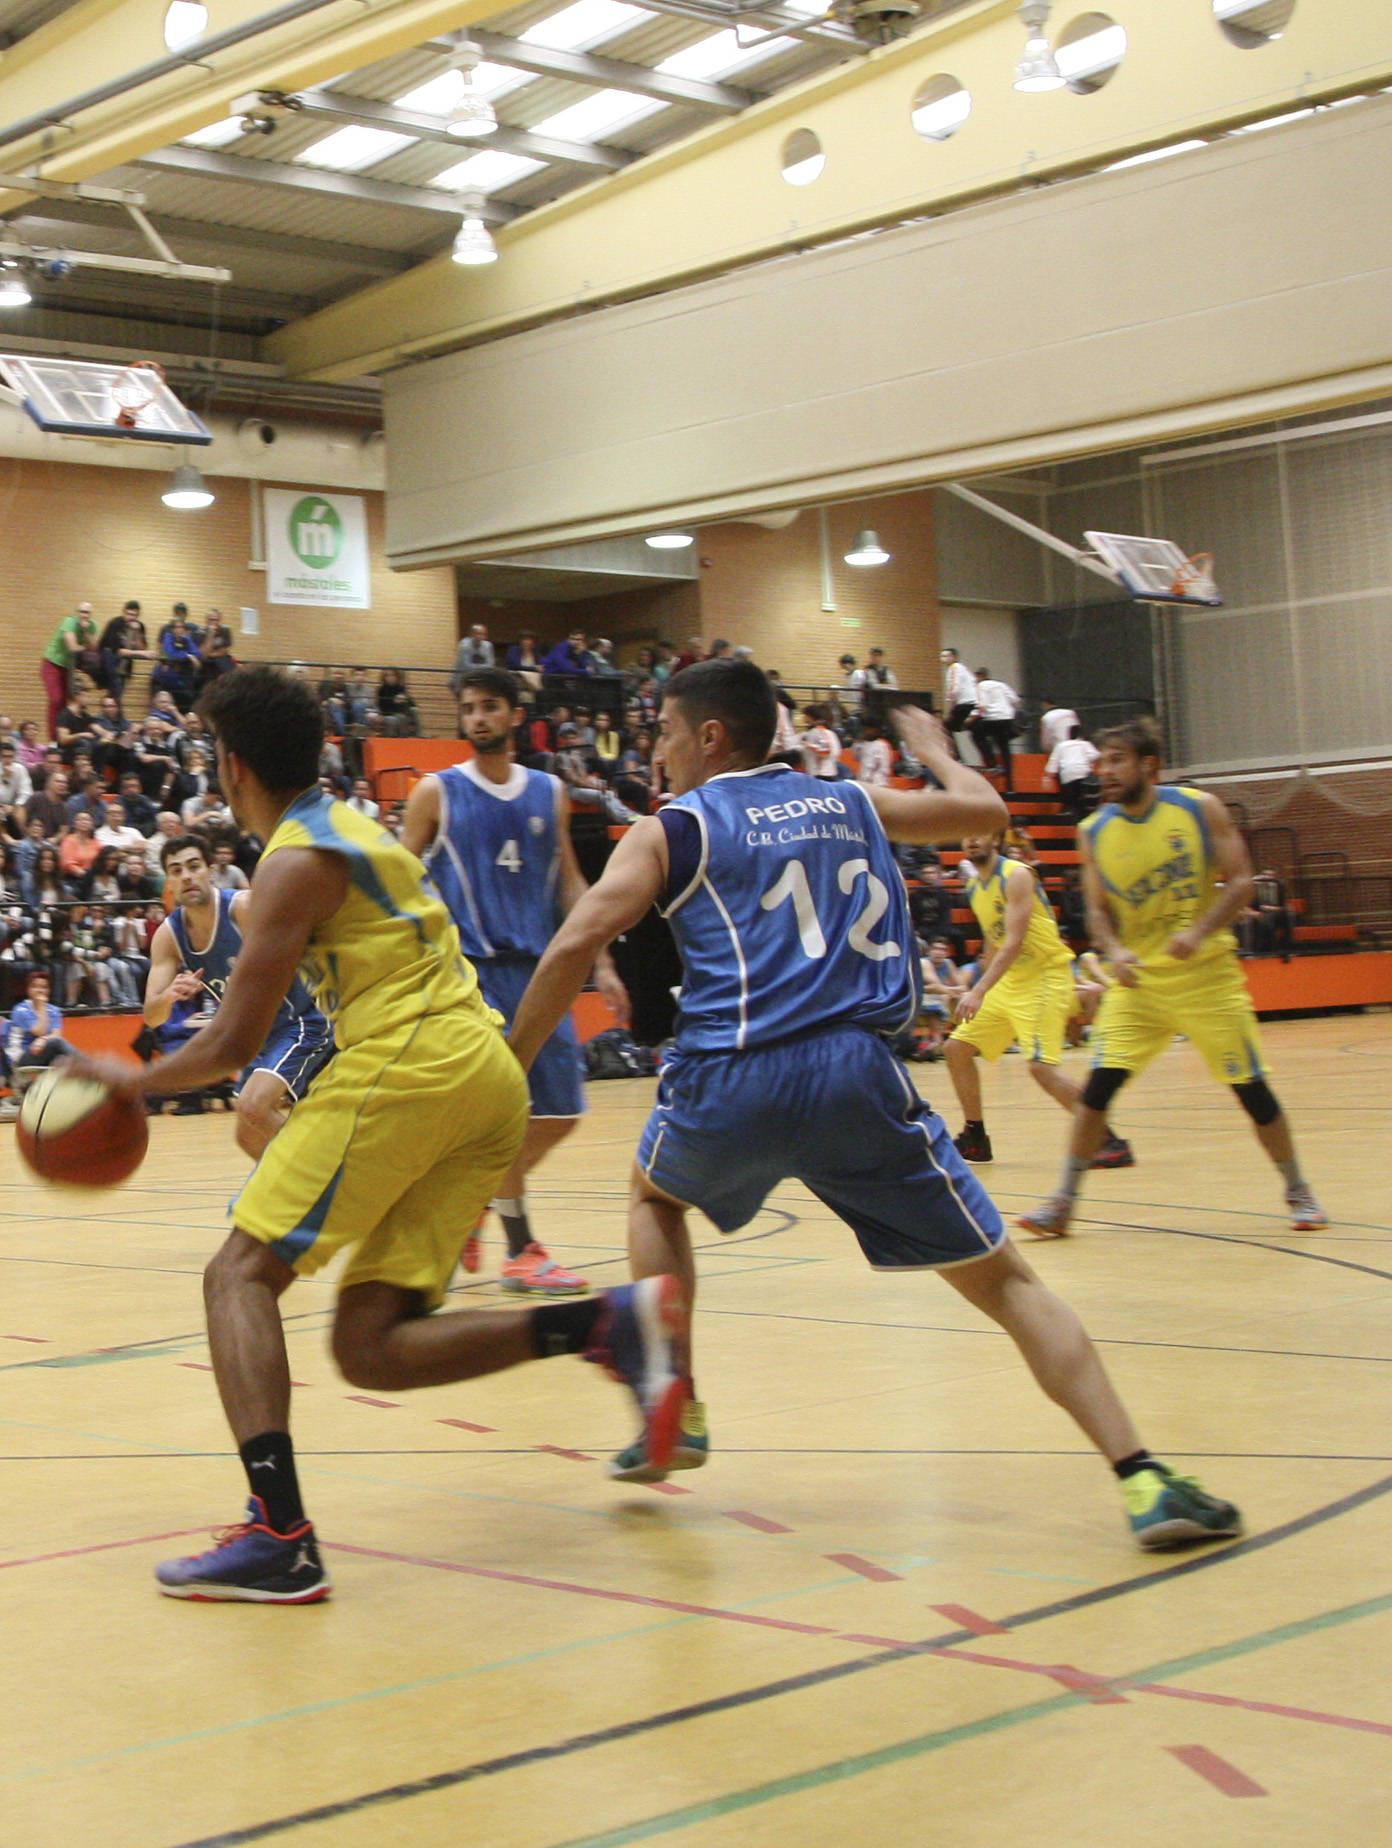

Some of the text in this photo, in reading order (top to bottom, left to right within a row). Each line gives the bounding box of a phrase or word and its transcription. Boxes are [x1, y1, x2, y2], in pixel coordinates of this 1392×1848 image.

[745, 797, 846, 825] PEDRO
[495, 839, 523, 873] 4
[760, 858, 901, 961] 12
